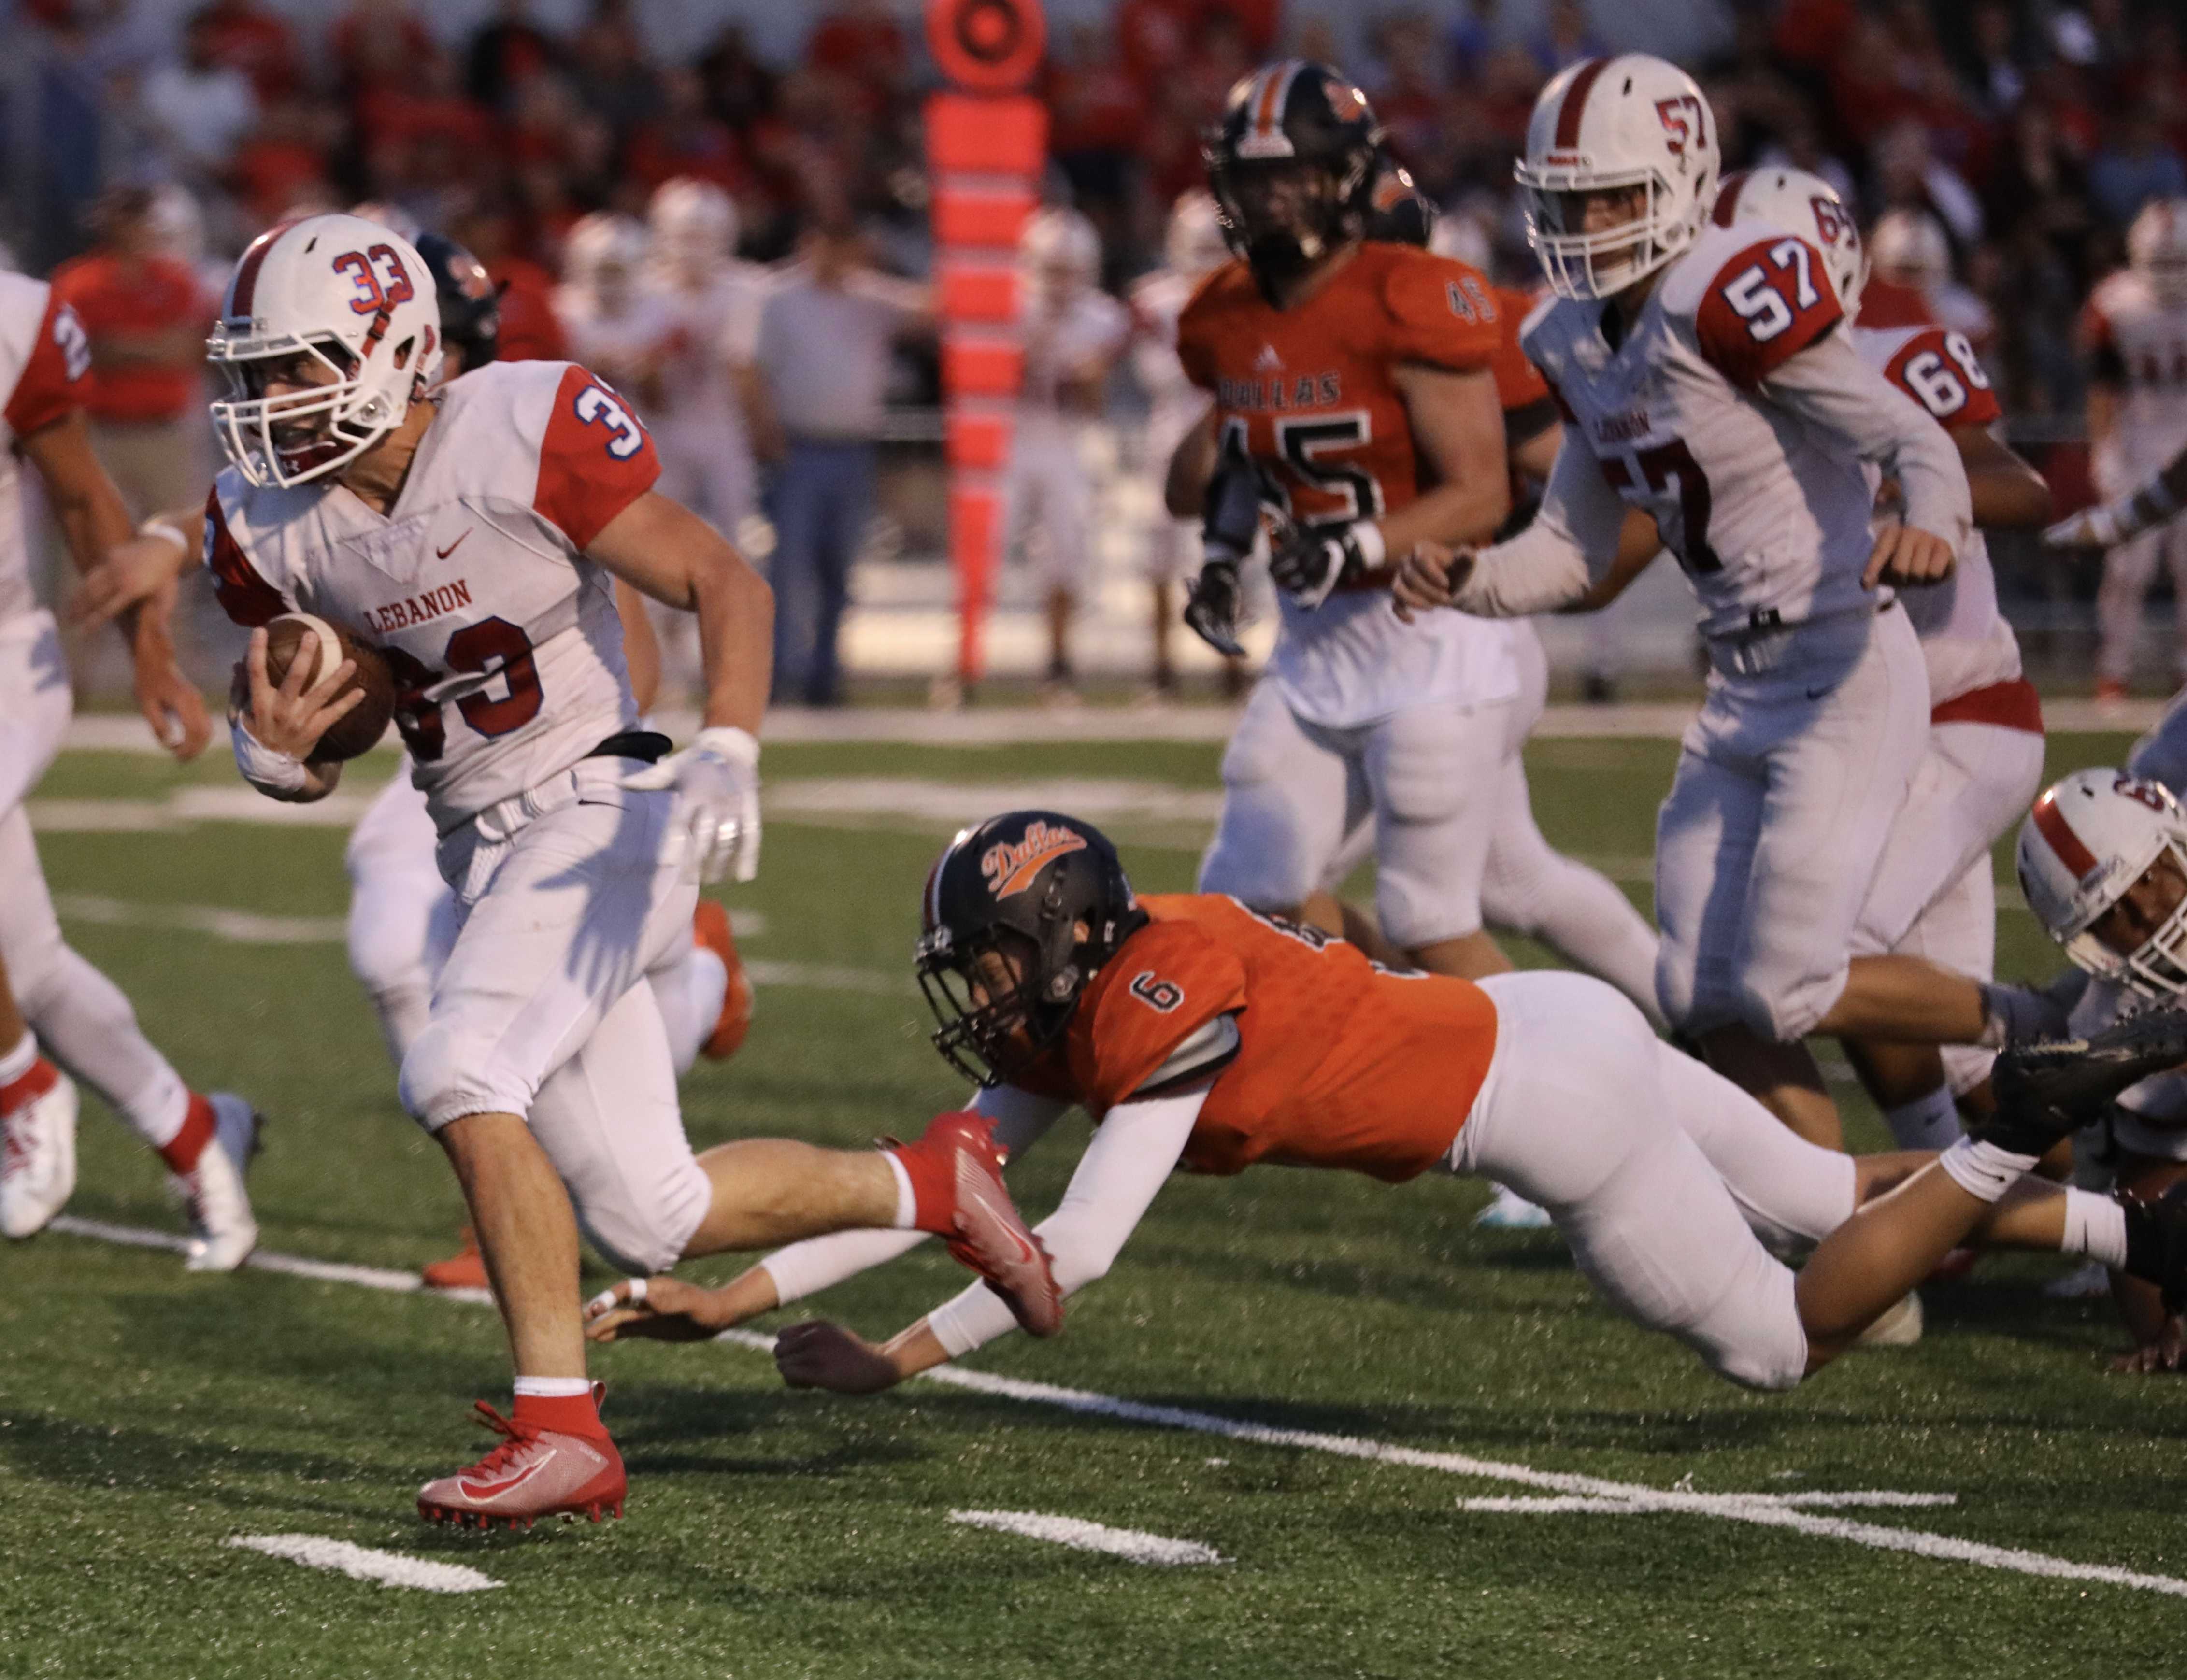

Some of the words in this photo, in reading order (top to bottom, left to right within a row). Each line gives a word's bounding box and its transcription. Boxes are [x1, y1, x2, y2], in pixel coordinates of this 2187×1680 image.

[1655, 94, 1707, 155] 57
[332, 243, 415, 315] 33
[1720, 237, 1822, 342] 57
[1902, 329, 1989, 418] 68
[363, 579, 472, 634] LEBANON
[982, 820, 1087, 898] Dallas
[1129, 970, 1185, 1014] 6
